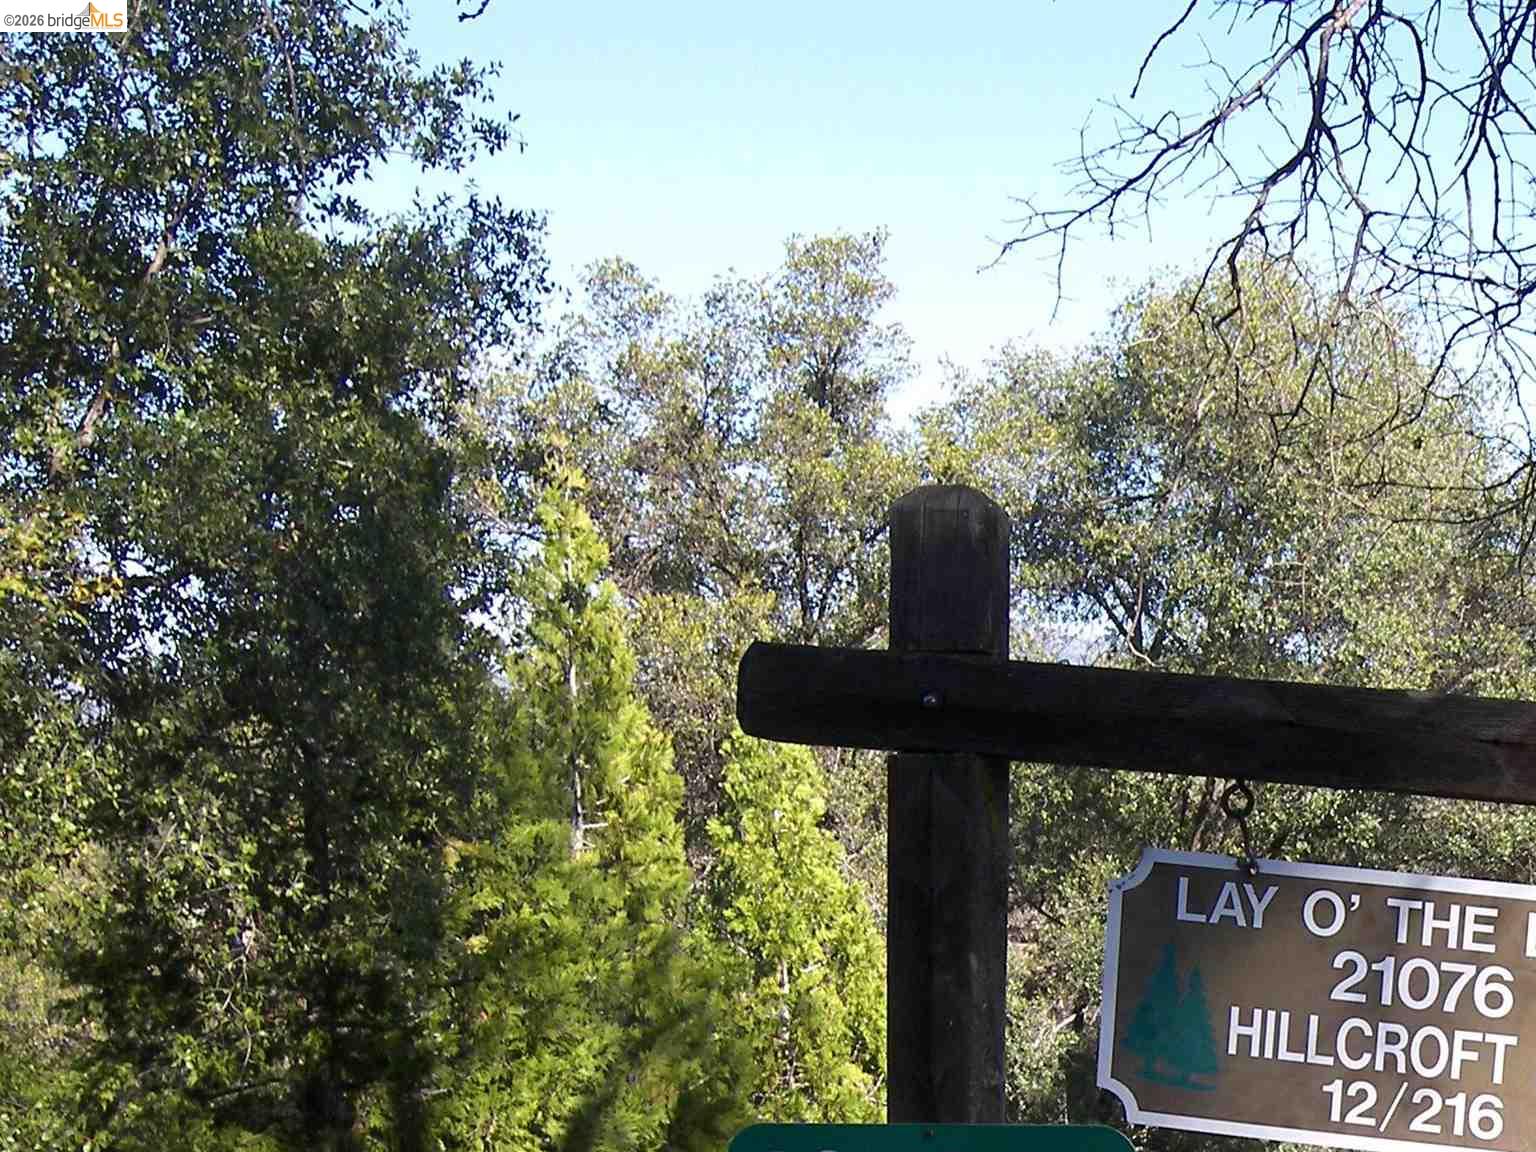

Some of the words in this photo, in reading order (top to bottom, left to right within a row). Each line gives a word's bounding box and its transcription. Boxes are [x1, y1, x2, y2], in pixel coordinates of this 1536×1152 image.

[1175, 876, 1279, 929] LAY
[1387, 897, 1498, 954] THE
[1329, 950, 1515, 1019] 21076
[1227, 1005, 1519, 1085] HILLCROFT
[1321, 1079, 1505, 1141] 12/216
